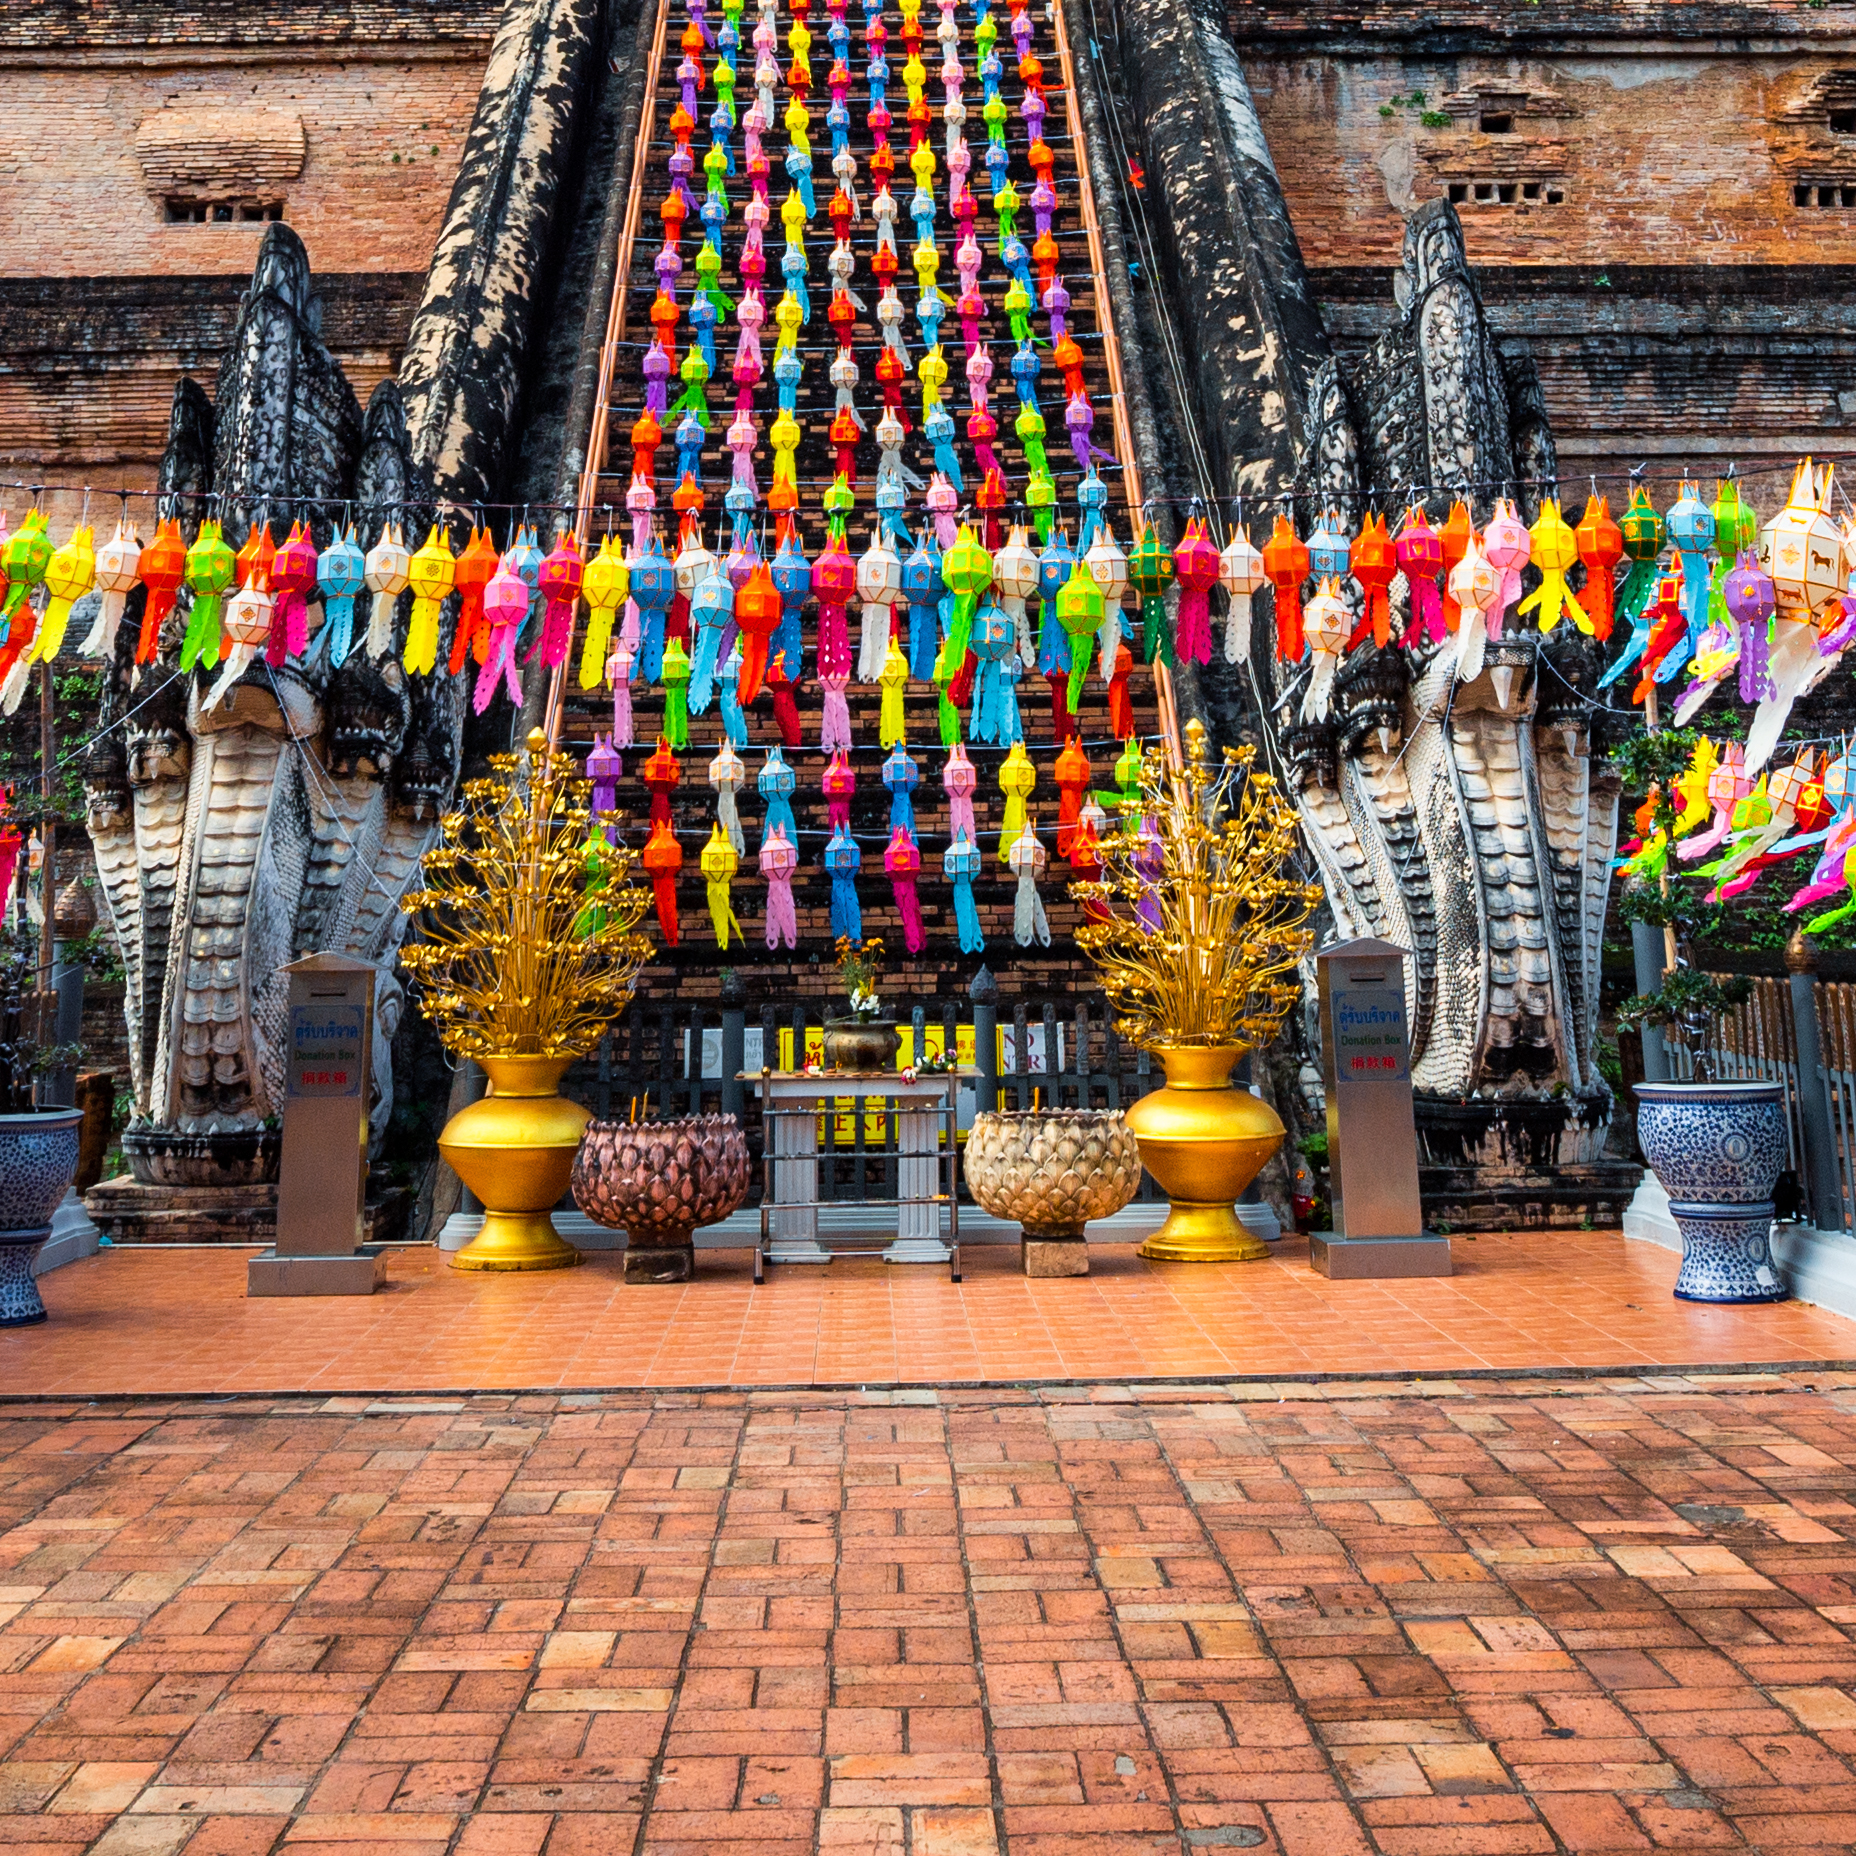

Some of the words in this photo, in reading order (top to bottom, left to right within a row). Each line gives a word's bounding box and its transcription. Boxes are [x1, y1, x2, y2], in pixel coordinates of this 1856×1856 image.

[1341, 1034, 1382, 1046] Donation
[1384, 1034, 1401, 1045] Box
[294, 1049, 336, 1061] Donation
[338, 1049, 356, 1060] Box
